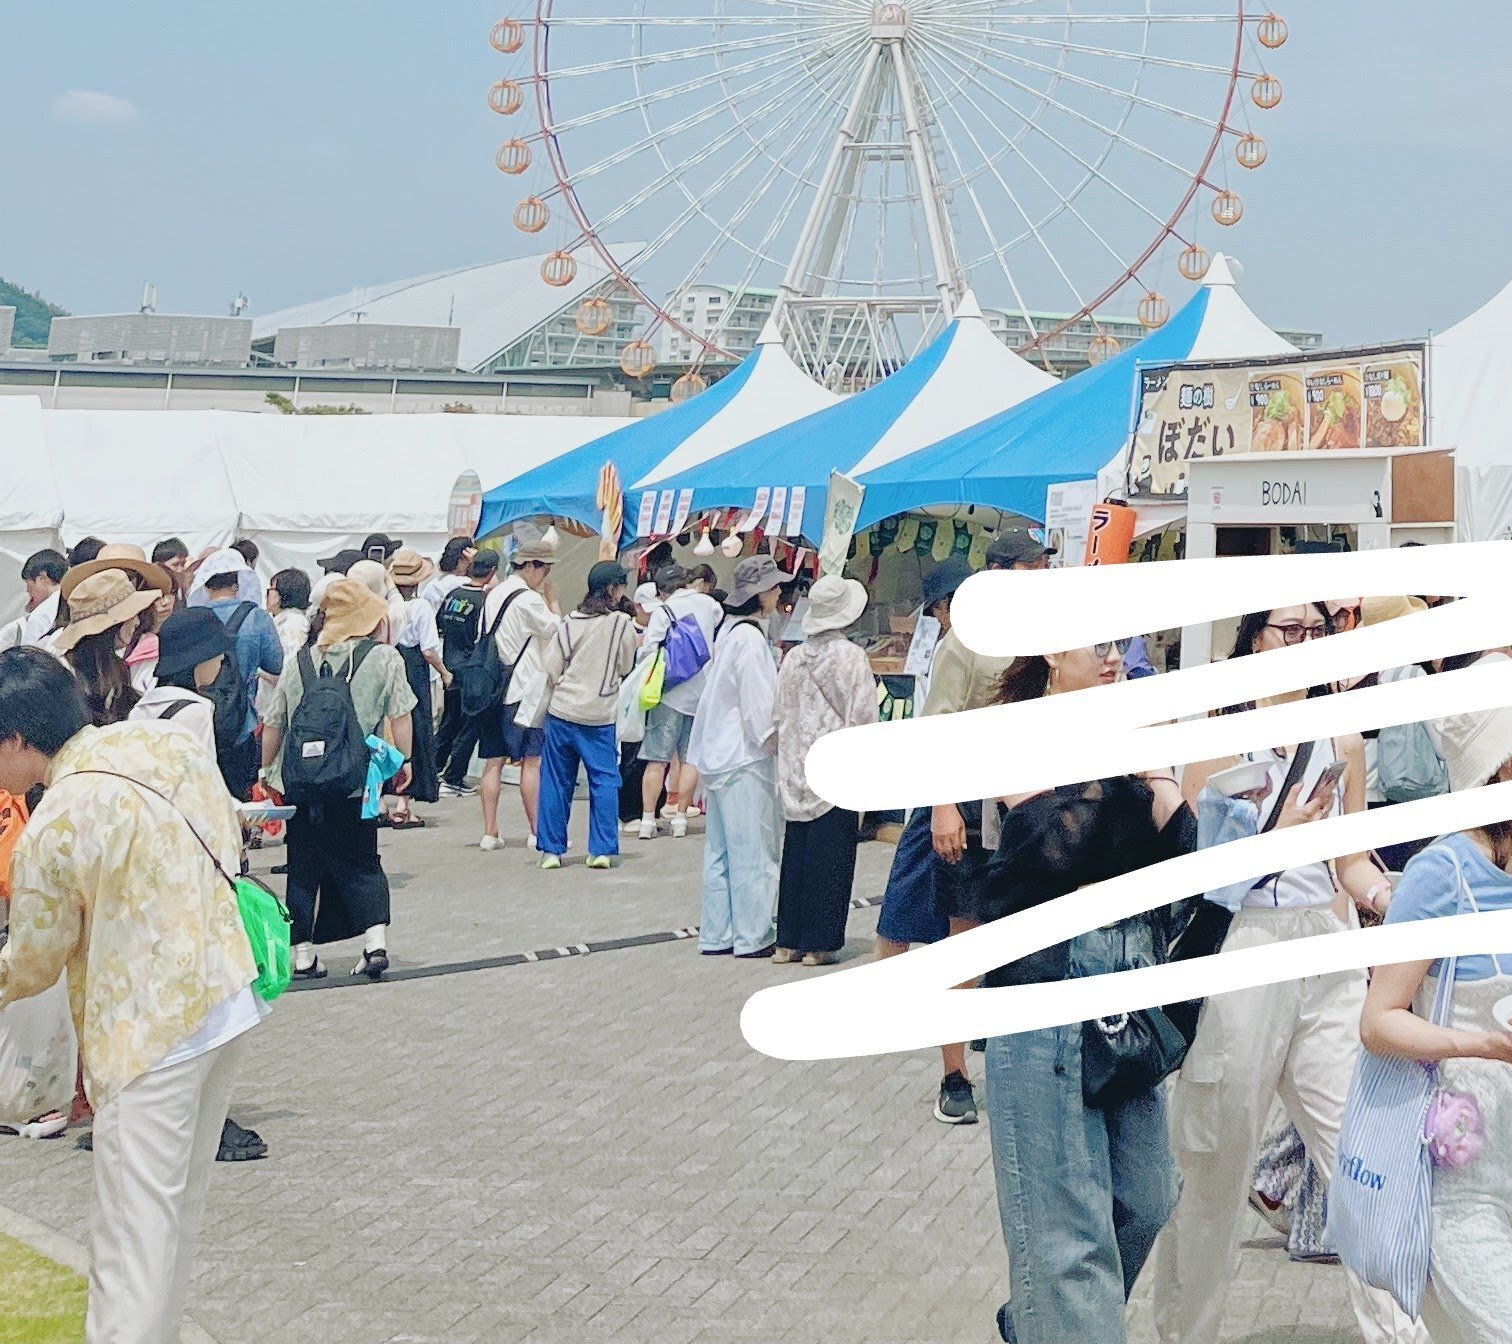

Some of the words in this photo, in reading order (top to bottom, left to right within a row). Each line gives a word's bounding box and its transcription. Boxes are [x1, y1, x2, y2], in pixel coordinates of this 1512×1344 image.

[1158, 416, 1235, 464] ぼだい
[1262, 480, 1308, 506] BODAI
[1087, 510, 1109, 567] ラー
